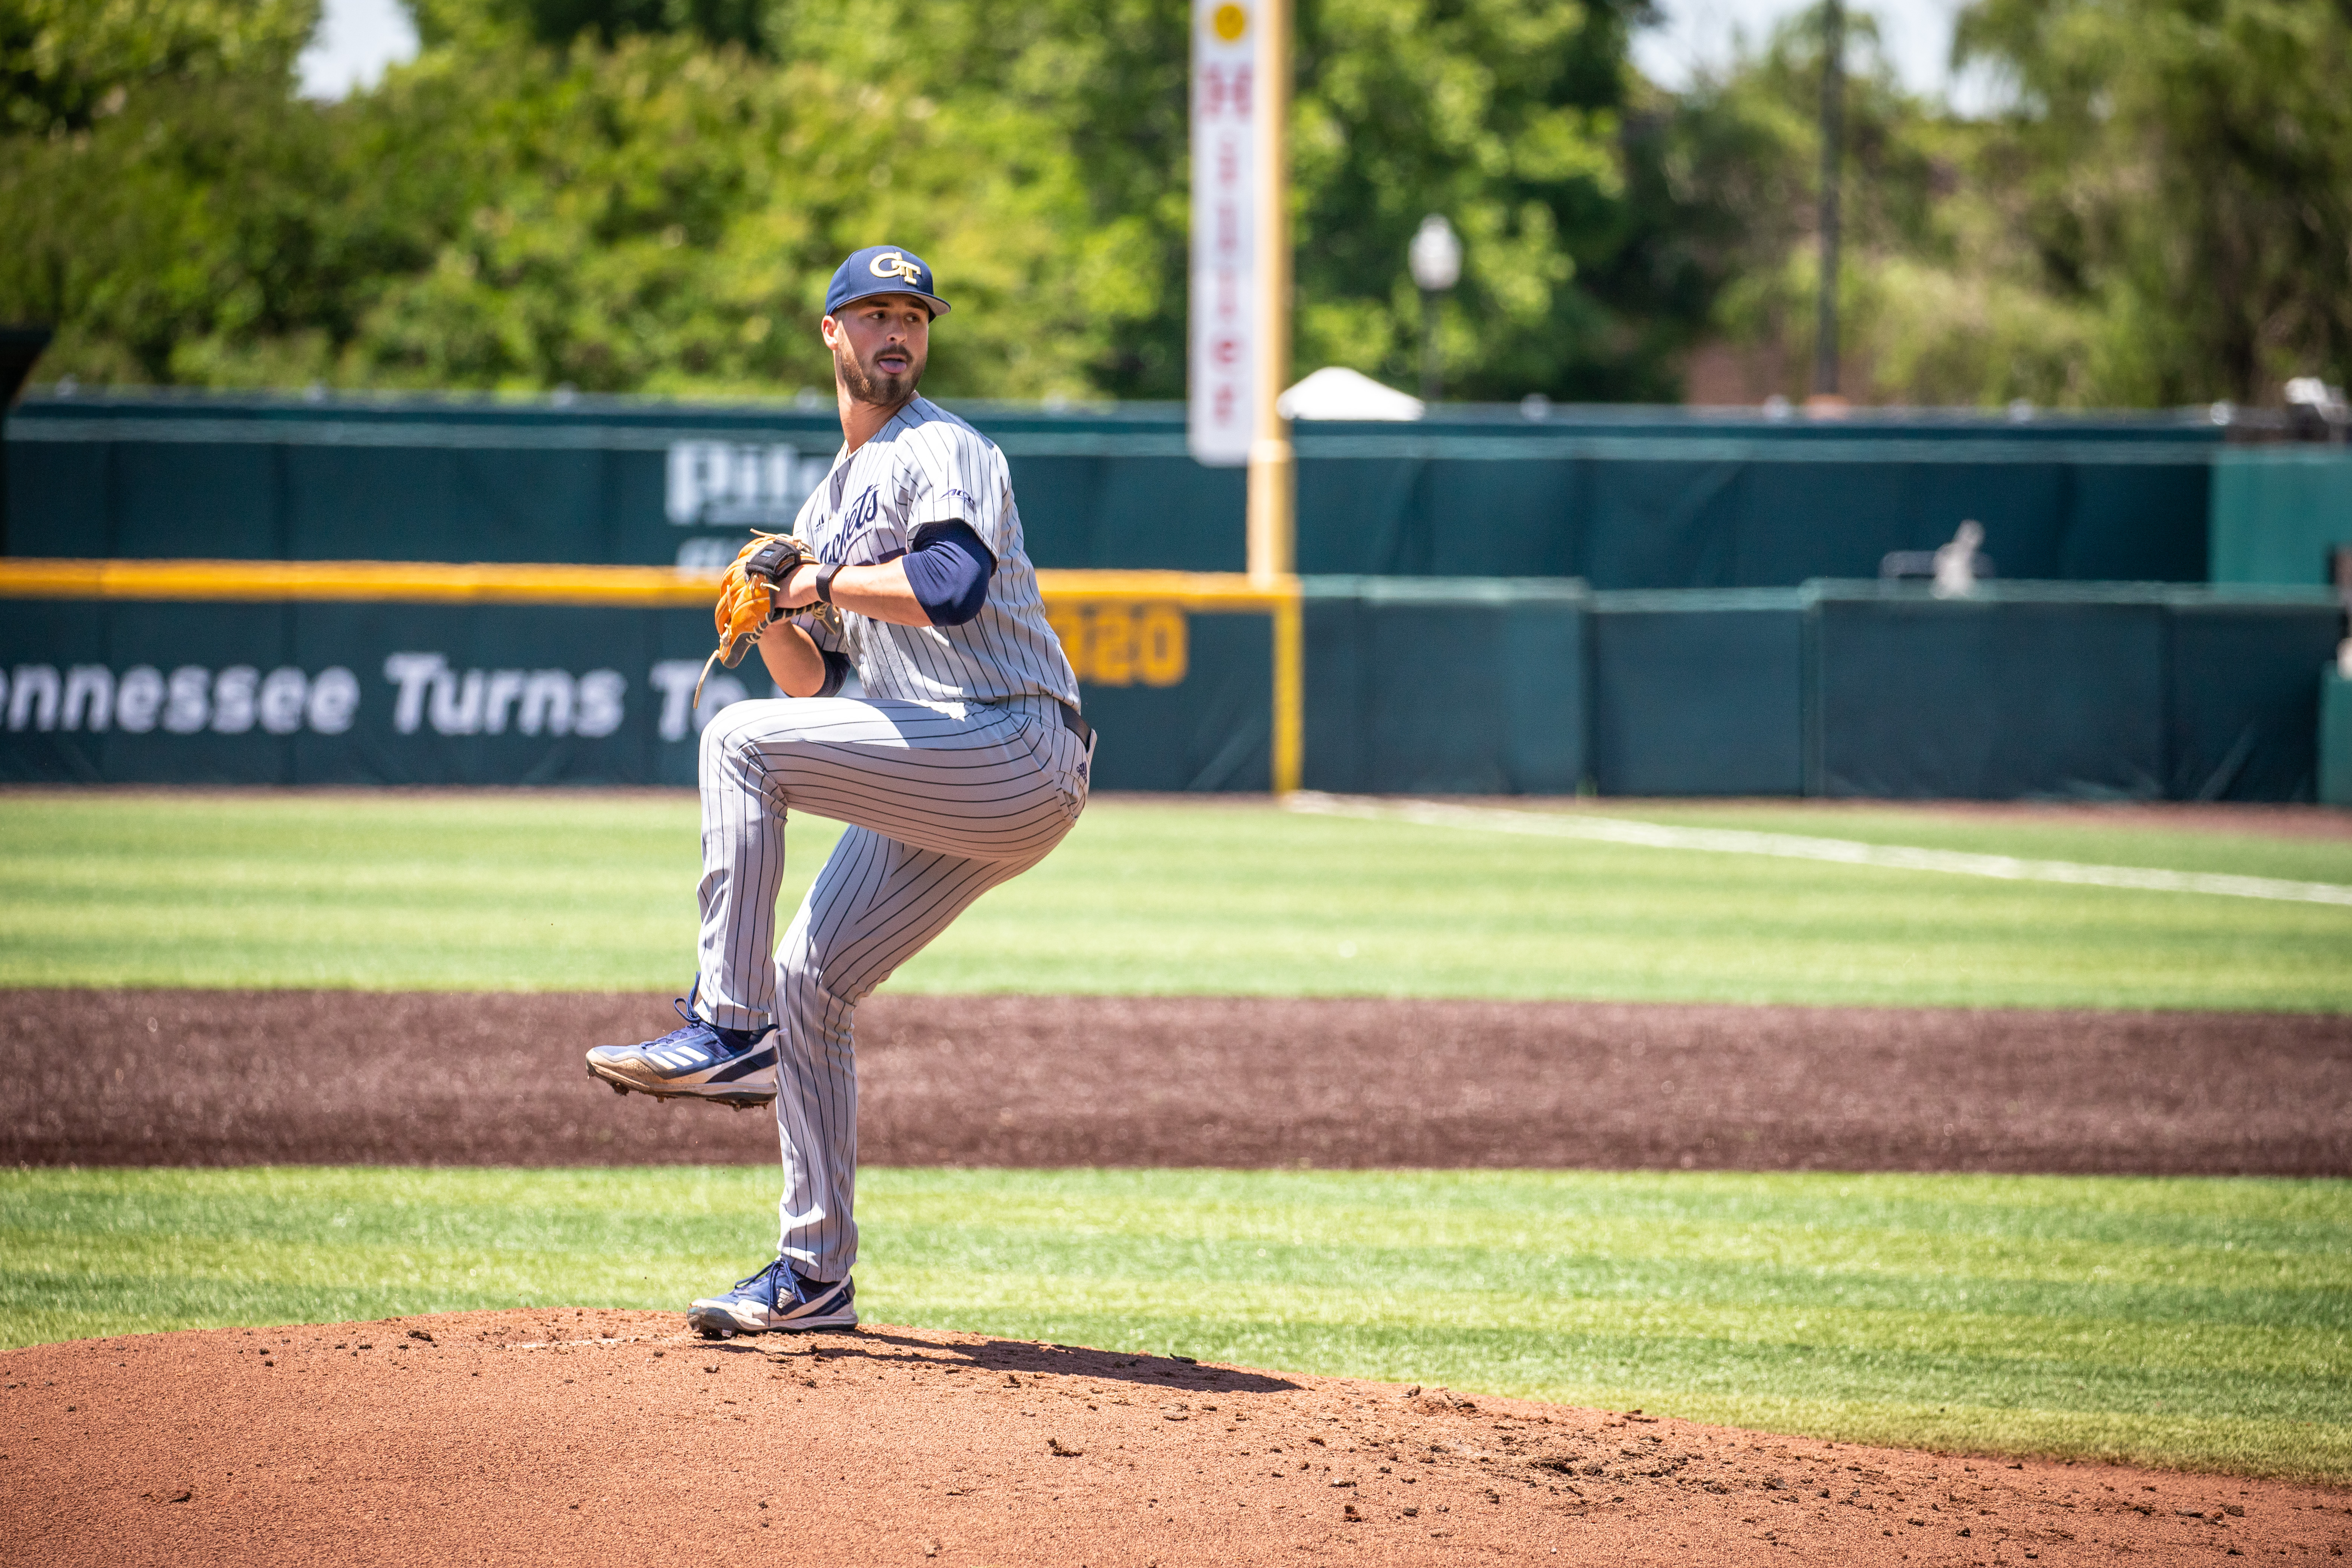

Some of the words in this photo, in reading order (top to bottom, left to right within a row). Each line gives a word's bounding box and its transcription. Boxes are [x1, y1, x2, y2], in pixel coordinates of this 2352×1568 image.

[870, 252, 921, 285] GT
[819, 484, 880, 564] ackets
[0, 662, 361, 736] nnessee
[384, 651, 627, 737] Turns
